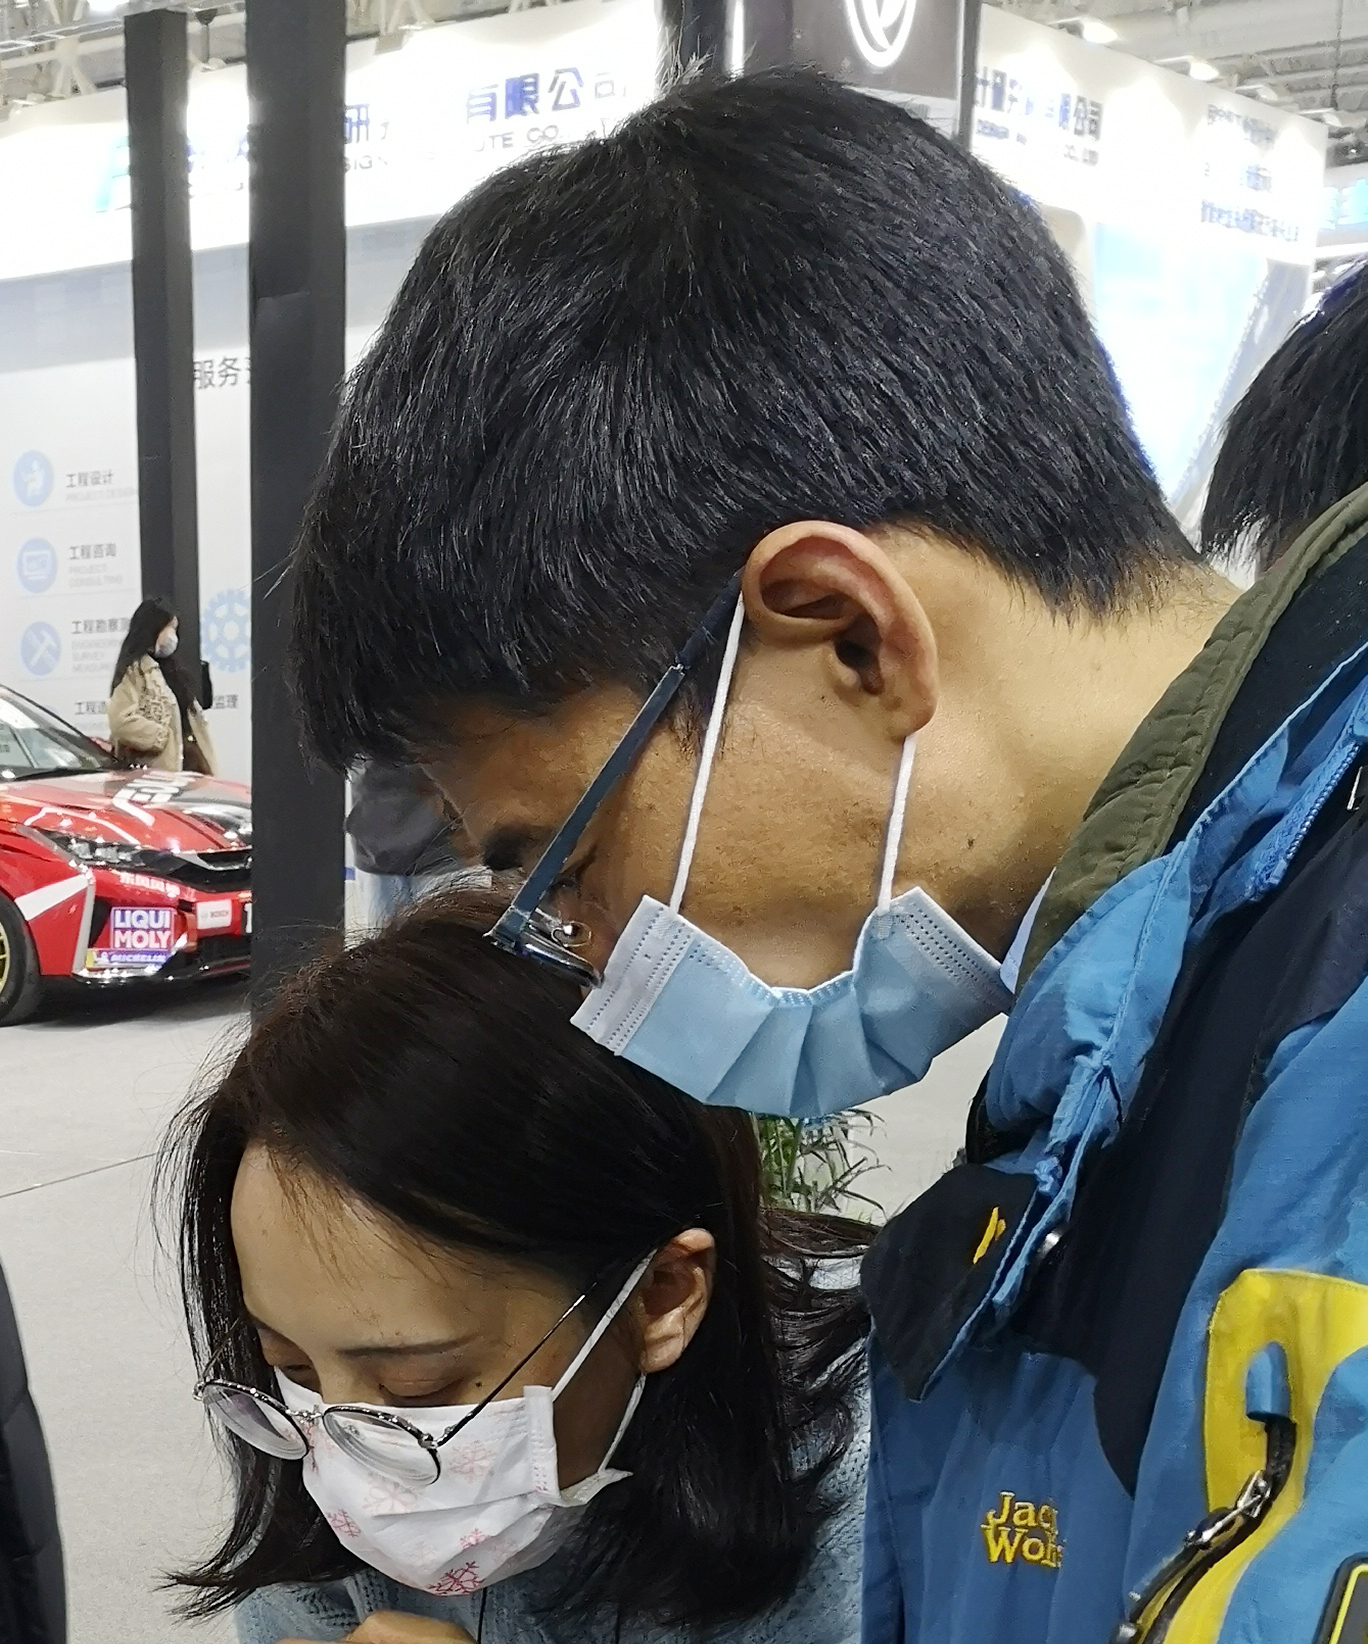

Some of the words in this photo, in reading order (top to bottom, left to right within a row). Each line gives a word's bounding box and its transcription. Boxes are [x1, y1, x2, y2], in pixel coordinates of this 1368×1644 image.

[193, 356, 250, 389] 服务
[114, 910, 171, 929] LIQUI
[114, 930, 171, 949] MOLY
